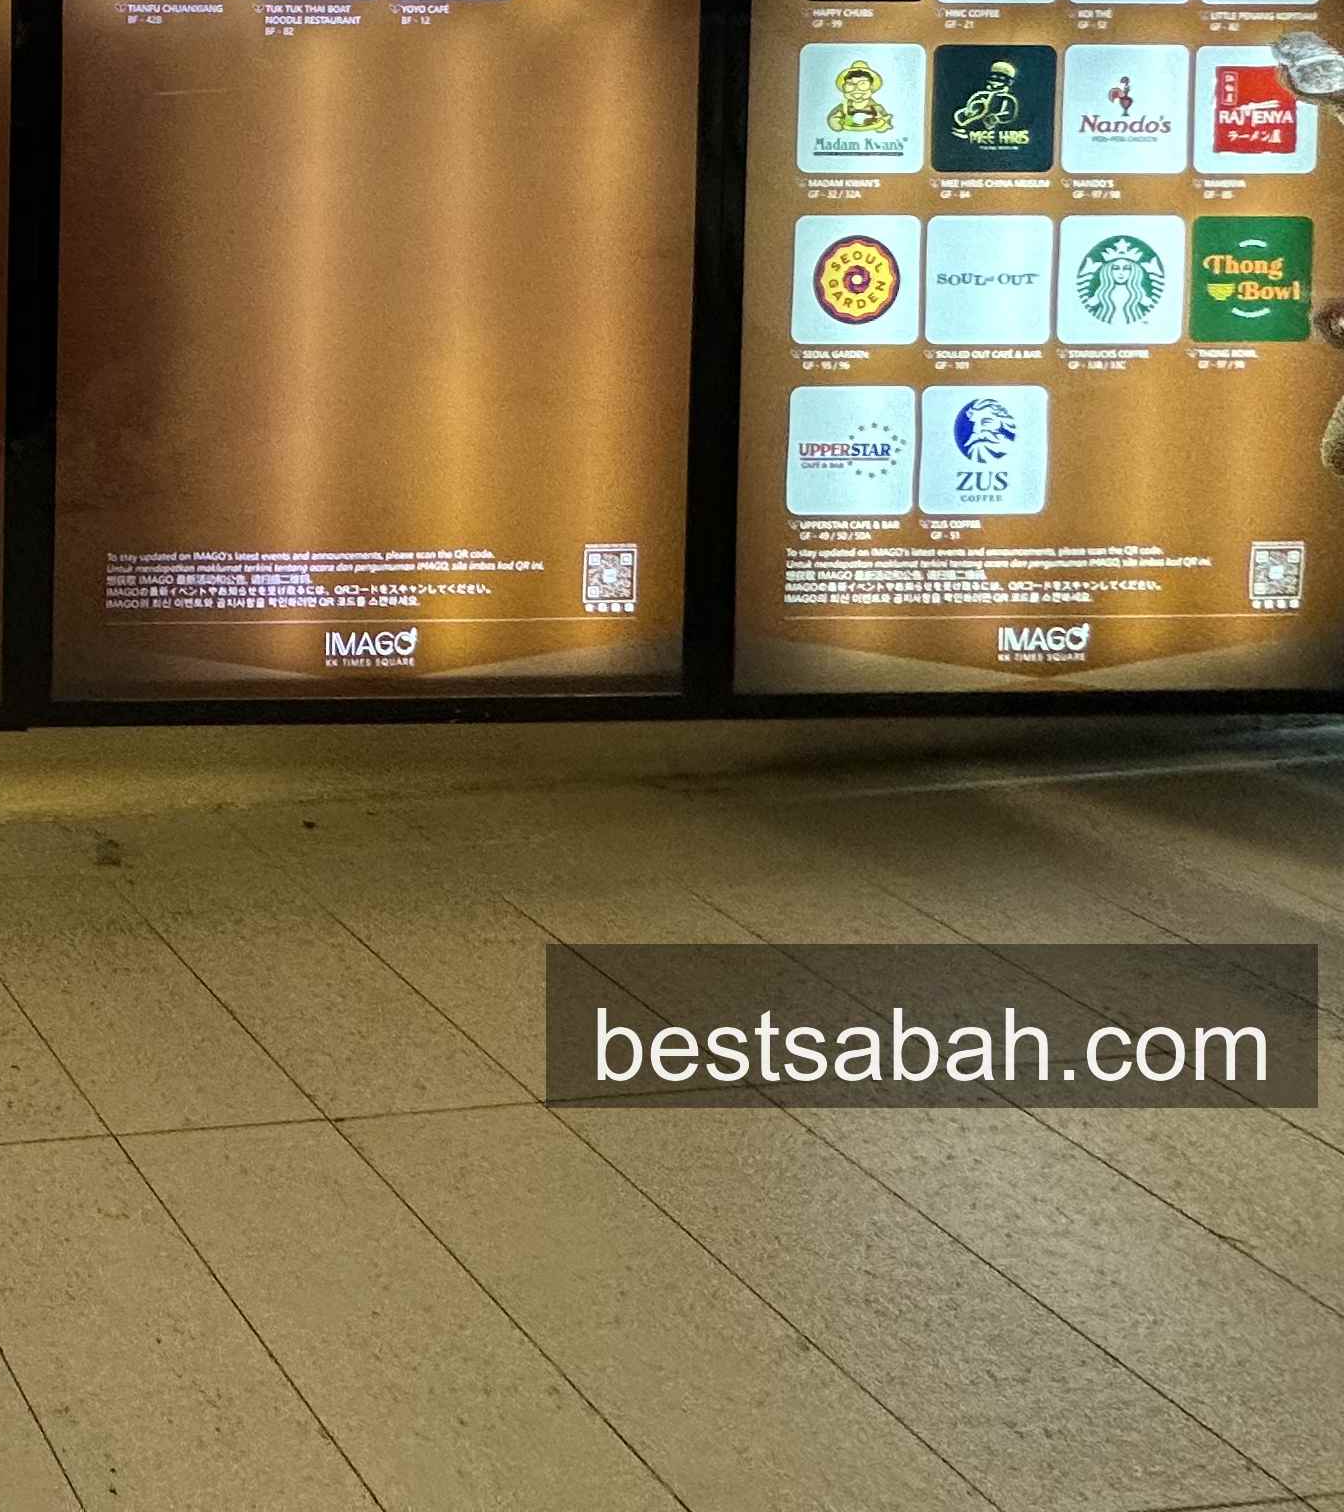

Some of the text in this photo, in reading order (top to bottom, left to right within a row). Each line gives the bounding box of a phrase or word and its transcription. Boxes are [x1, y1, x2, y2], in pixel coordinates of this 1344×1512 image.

[813, 9, 874, 17] HAPPY CHUBS
[1079, 115, 1171, 133] Nando's
[814, 138, 861, 151] Madam
[1203, 255, 1284, 279] Thong
[1238, 281, 1300, 300] Bowl
[799, 443, 891, 458] UPPERSTAR
[956, 472, 1008, 491] ZUS
